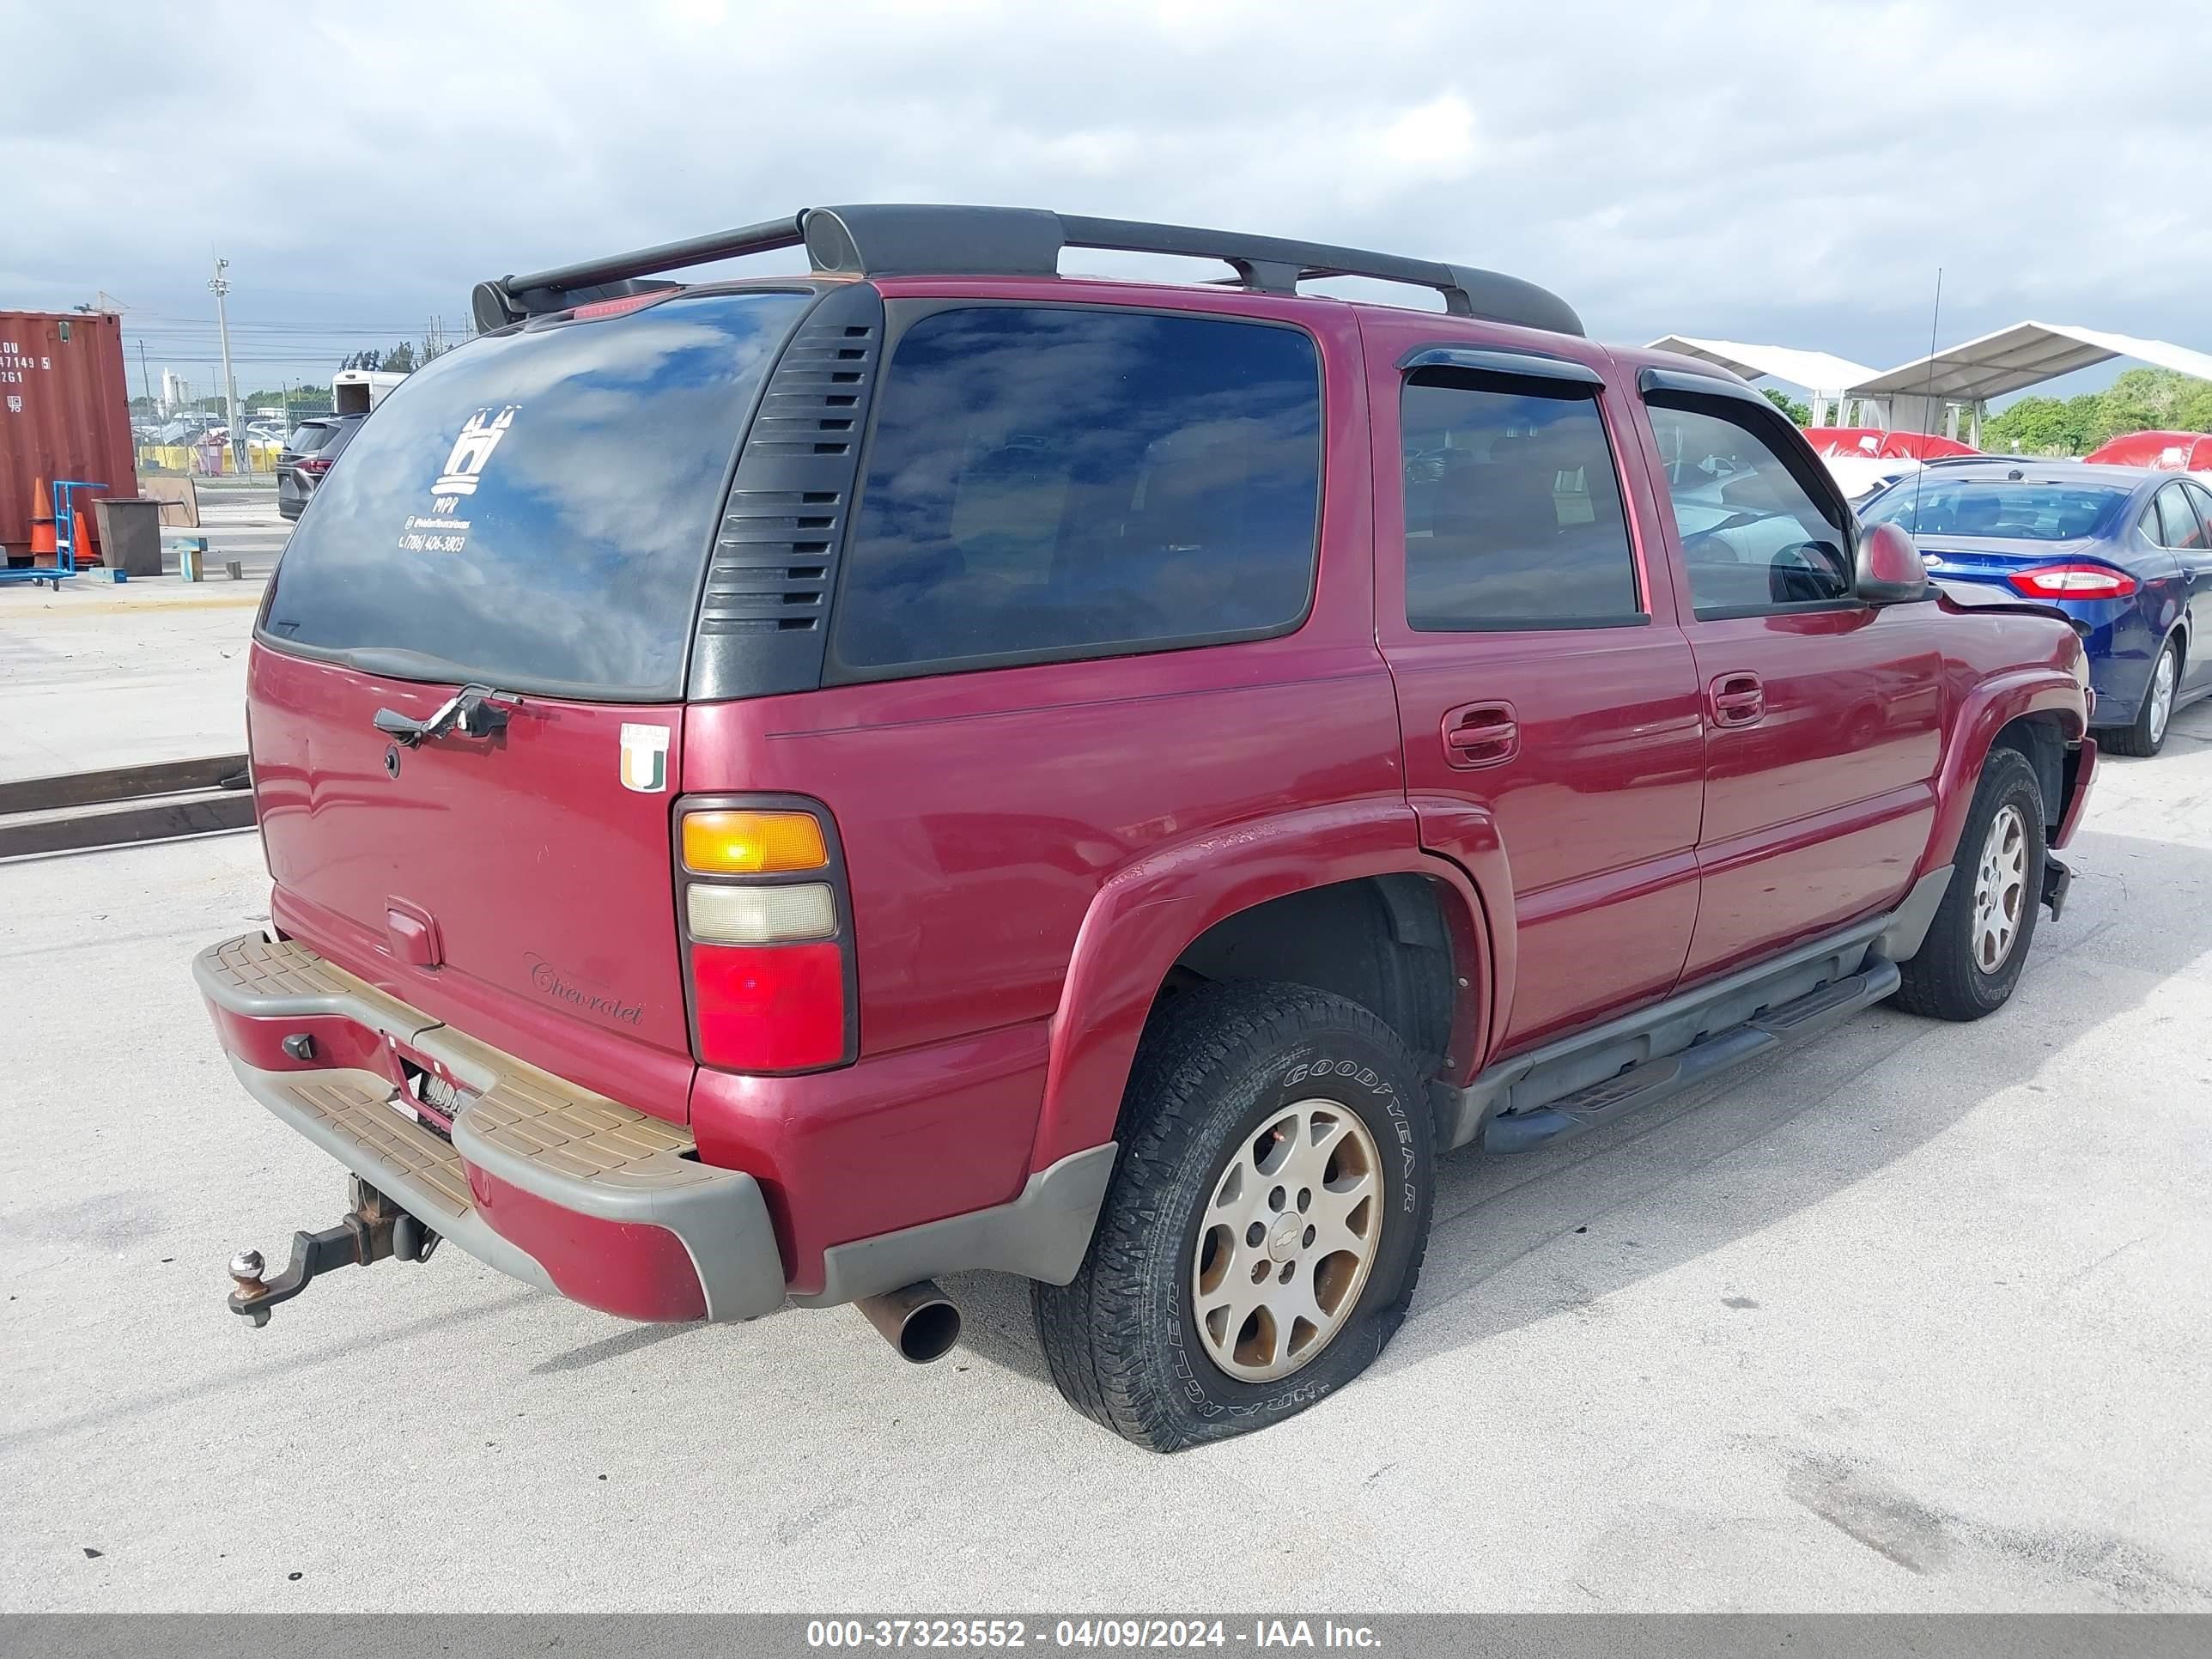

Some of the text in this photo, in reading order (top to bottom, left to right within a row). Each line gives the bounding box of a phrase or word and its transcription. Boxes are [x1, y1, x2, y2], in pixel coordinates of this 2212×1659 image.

[41, 357, 50, 369] 5
[432, 496, 459, 514] MPR
[404, 532, 465, 552] (786) 406-3803
[523, 951, 644, 1025] Chevrolet
[1284, 1059, 1416, 1213] GOODYEAR
[1166, 1282, 1330, 1419] WRANGLER
